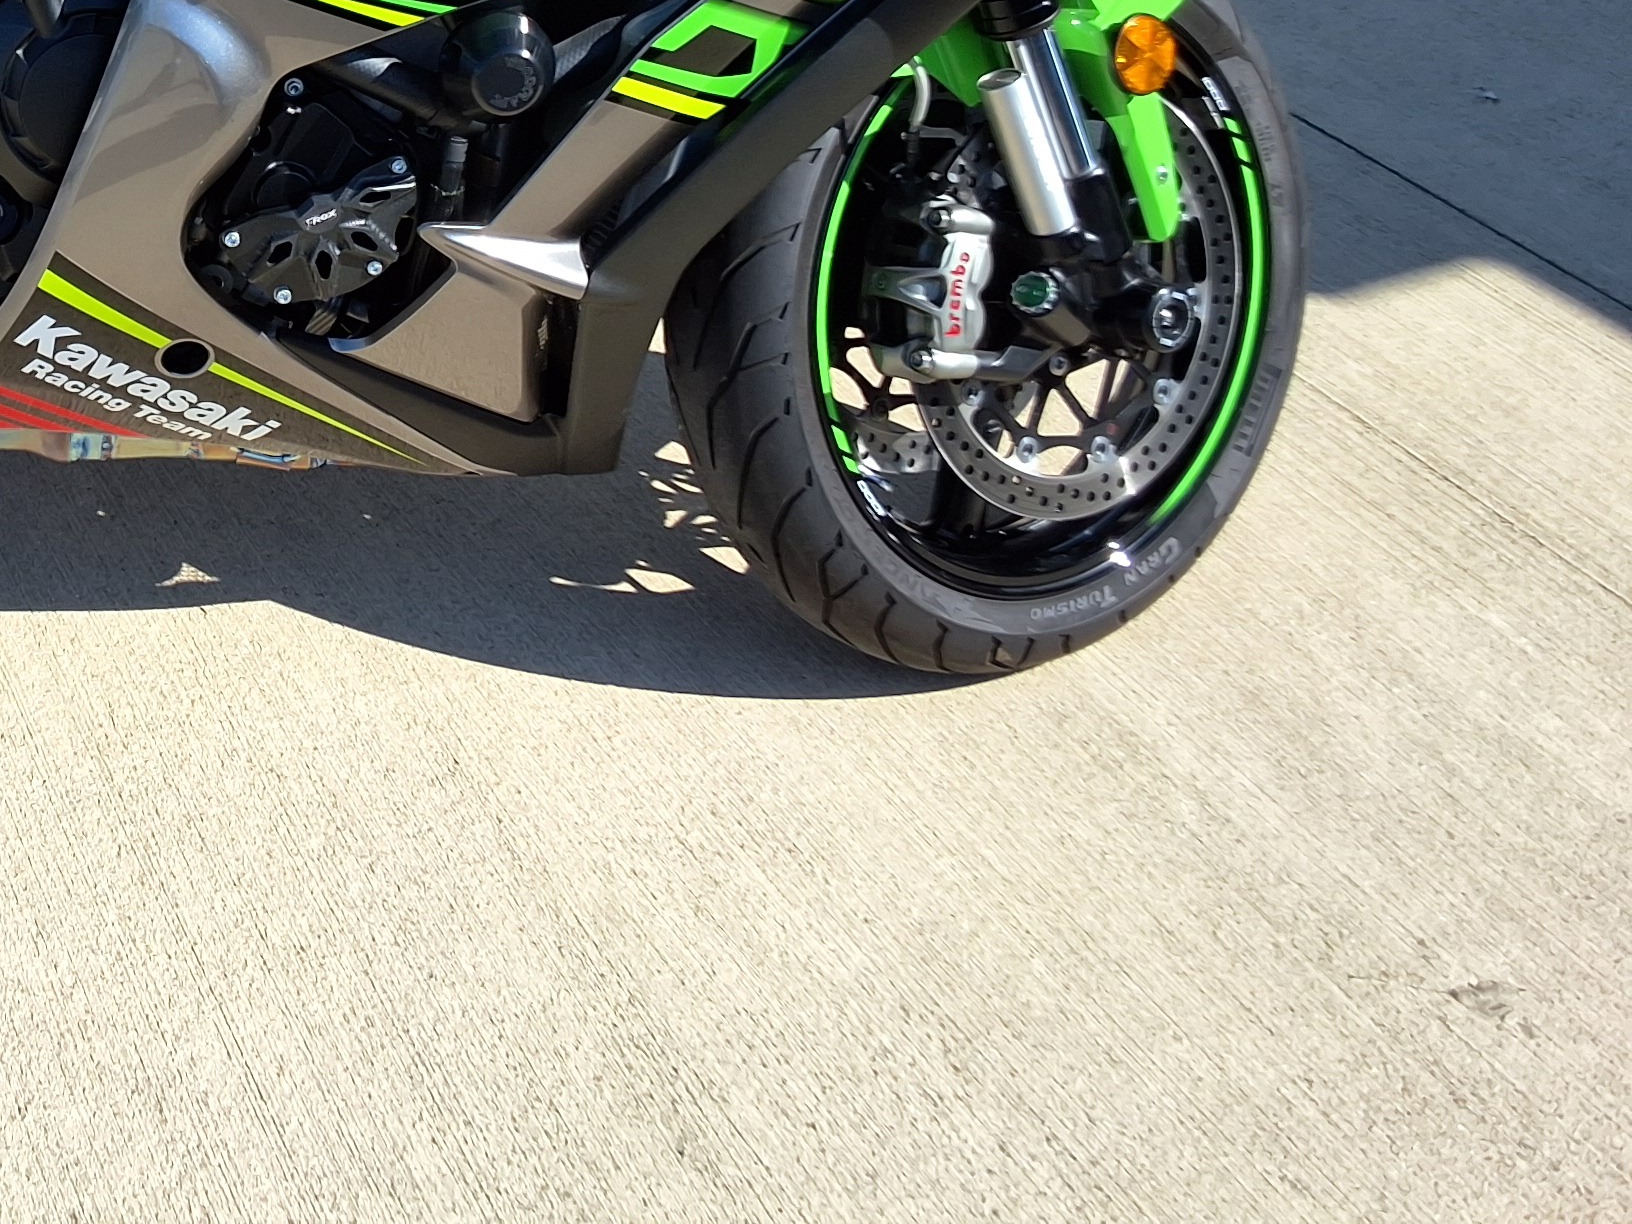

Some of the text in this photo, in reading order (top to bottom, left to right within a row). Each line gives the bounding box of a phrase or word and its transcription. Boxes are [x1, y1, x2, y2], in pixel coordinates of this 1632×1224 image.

[944, 251, 971, 338] brembo
[14, 314, 282, 441] Kawasaki
[20, 358, 213, 441] Racing Team
[1030, 536, 1183, 621] GRAN TURISMO
